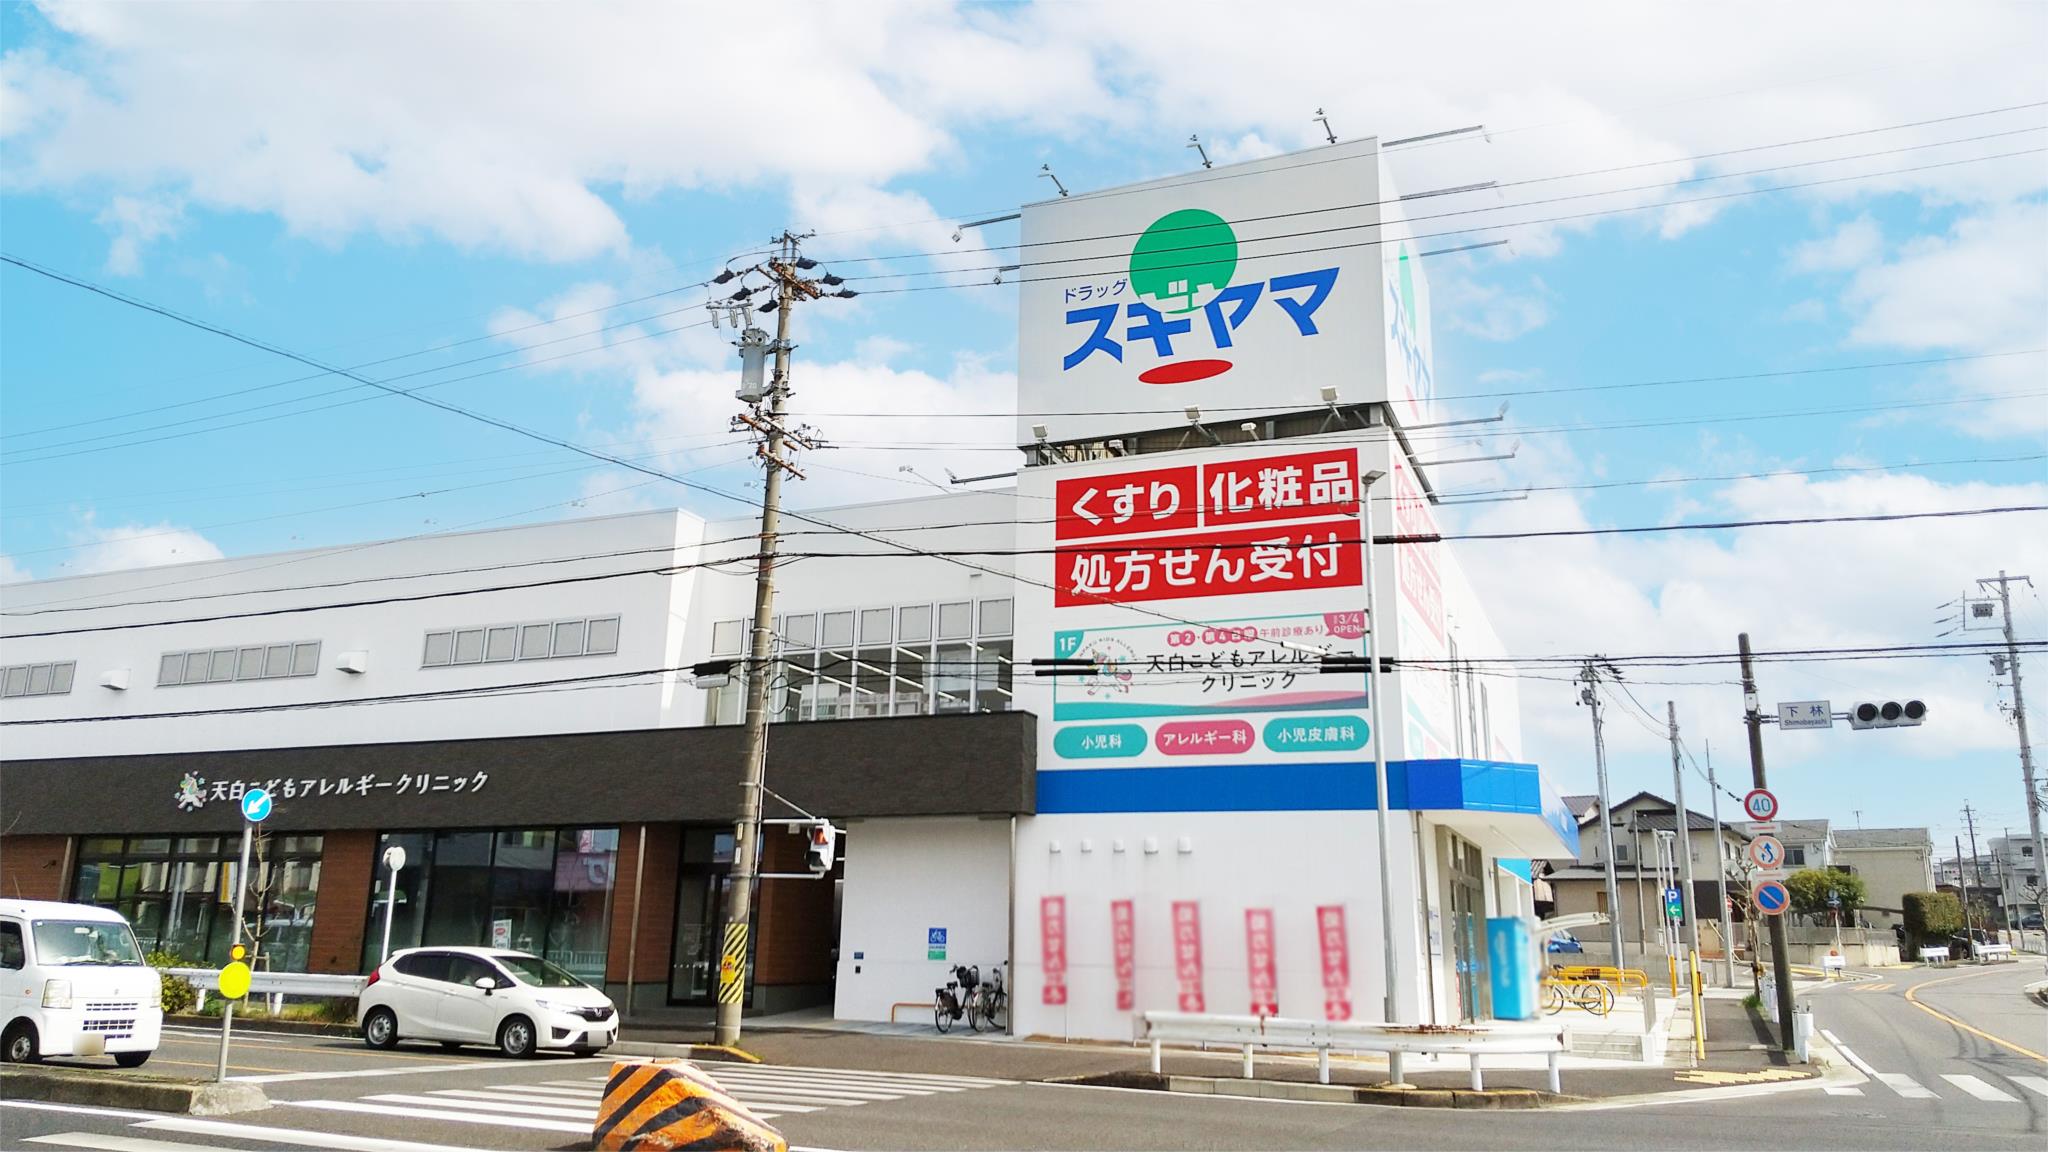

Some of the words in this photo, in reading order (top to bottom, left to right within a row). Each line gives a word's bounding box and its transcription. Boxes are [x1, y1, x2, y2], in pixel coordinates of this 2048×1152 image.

[1064, 278, 1129, 304] ドラッグ
[1063, 266, 1341, 372] スギヤマ
[1209, 460, 1352, 516] 化粧品
[1071, 480, 1182, 527] くすり
[1070, 531, 1342, 596] 処方せん受付
[1333, 624, 1360, 634] OPEN
[1059, 637, 1076, 651] 1F
[1201, 671, 1296, 693] クリニック
[1785, 704, 1824, 718] 下林
[1081, 734, 1122, 749] 小児科
[1163, 728, 1247, 746] アレルギー科
[1278, 726, 1356, 743] 小児皮膚科
[1752, 798, 1771, 812] 40
[1667, 890, 1678, 903] P
